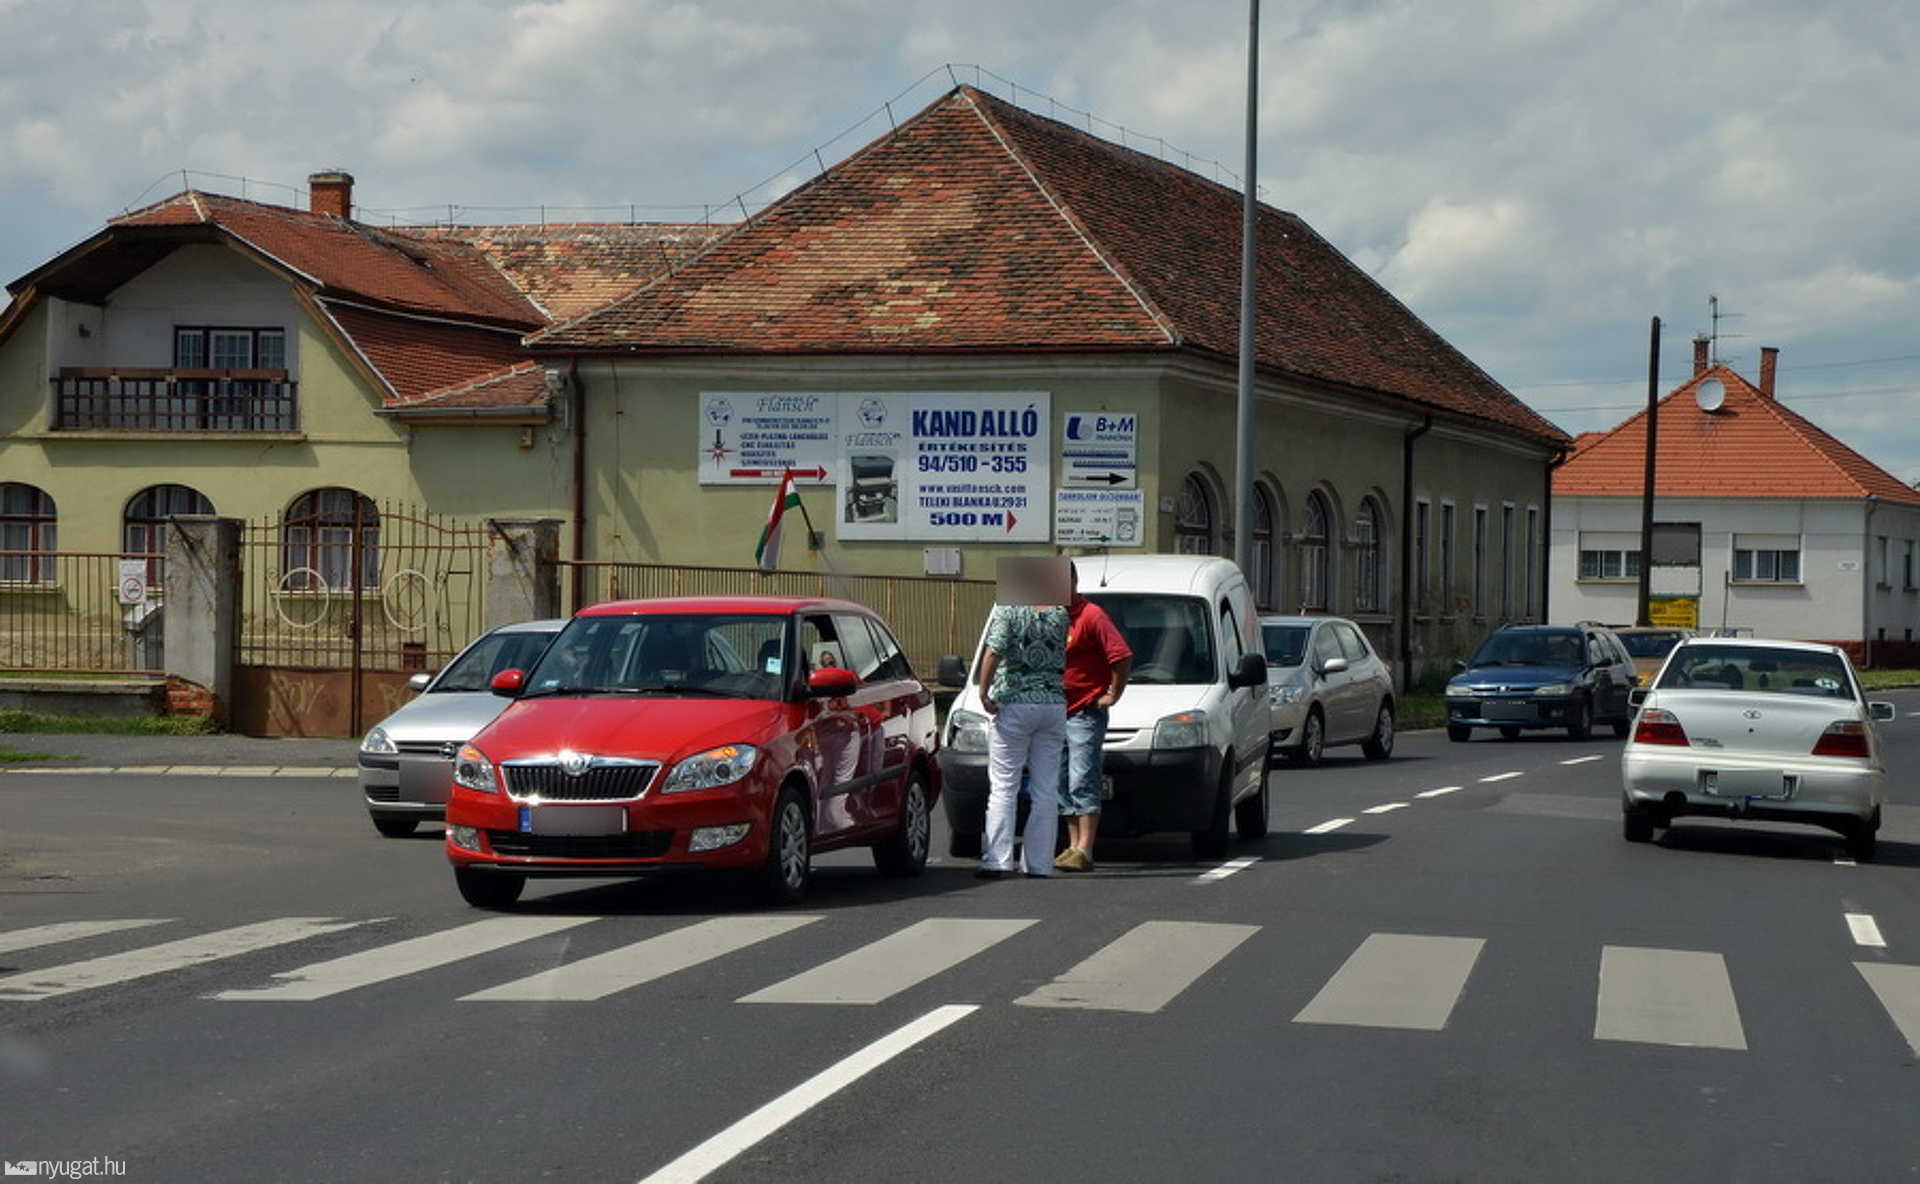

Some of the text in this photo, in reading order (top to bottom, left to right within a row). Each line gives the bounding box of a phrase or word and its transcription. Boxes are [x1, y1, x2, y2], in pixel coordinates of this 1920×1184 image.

[912, 403, 1038, 437] KANDALLÓ
[1096, 416, 1134, 432] B+M
[918, 441, 1027, 452] ÉRTÉKESÍTÉS
[919, 497, 950, 507] TELEKI
[929, 512, 1003, 526] 500 M
